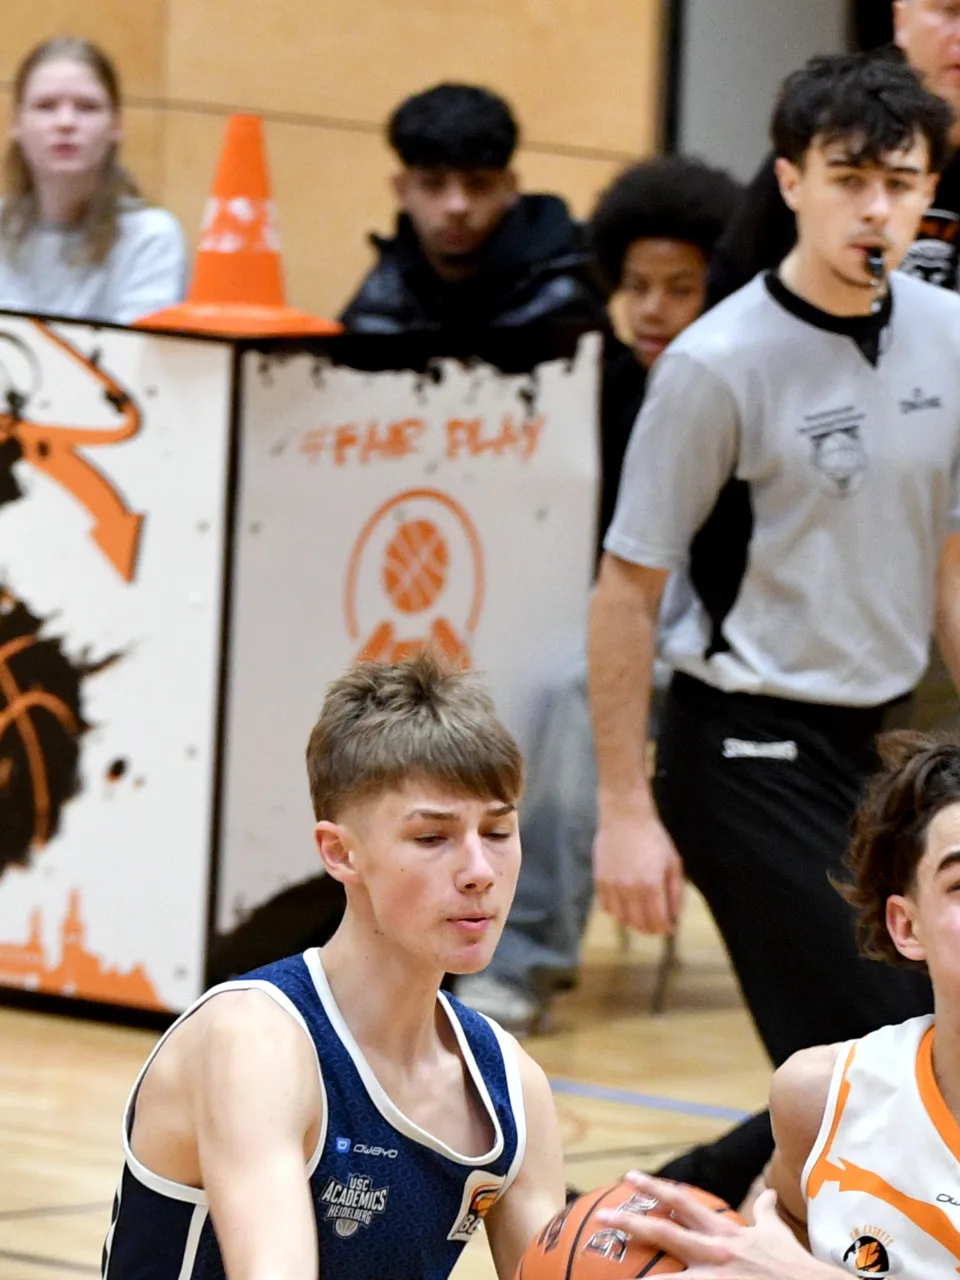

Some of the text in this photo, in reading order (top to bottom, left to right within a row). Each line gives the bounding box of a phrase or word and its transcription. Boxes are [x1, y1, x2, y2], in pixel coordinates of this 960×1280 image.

[447, 414, 546, 463] PLAY
[322, 1181, 387, 1211] ACADEMICS
[349, 1177, 370, 1191] USC
[327, 1205, 373, 1225] HEIDELBERG
